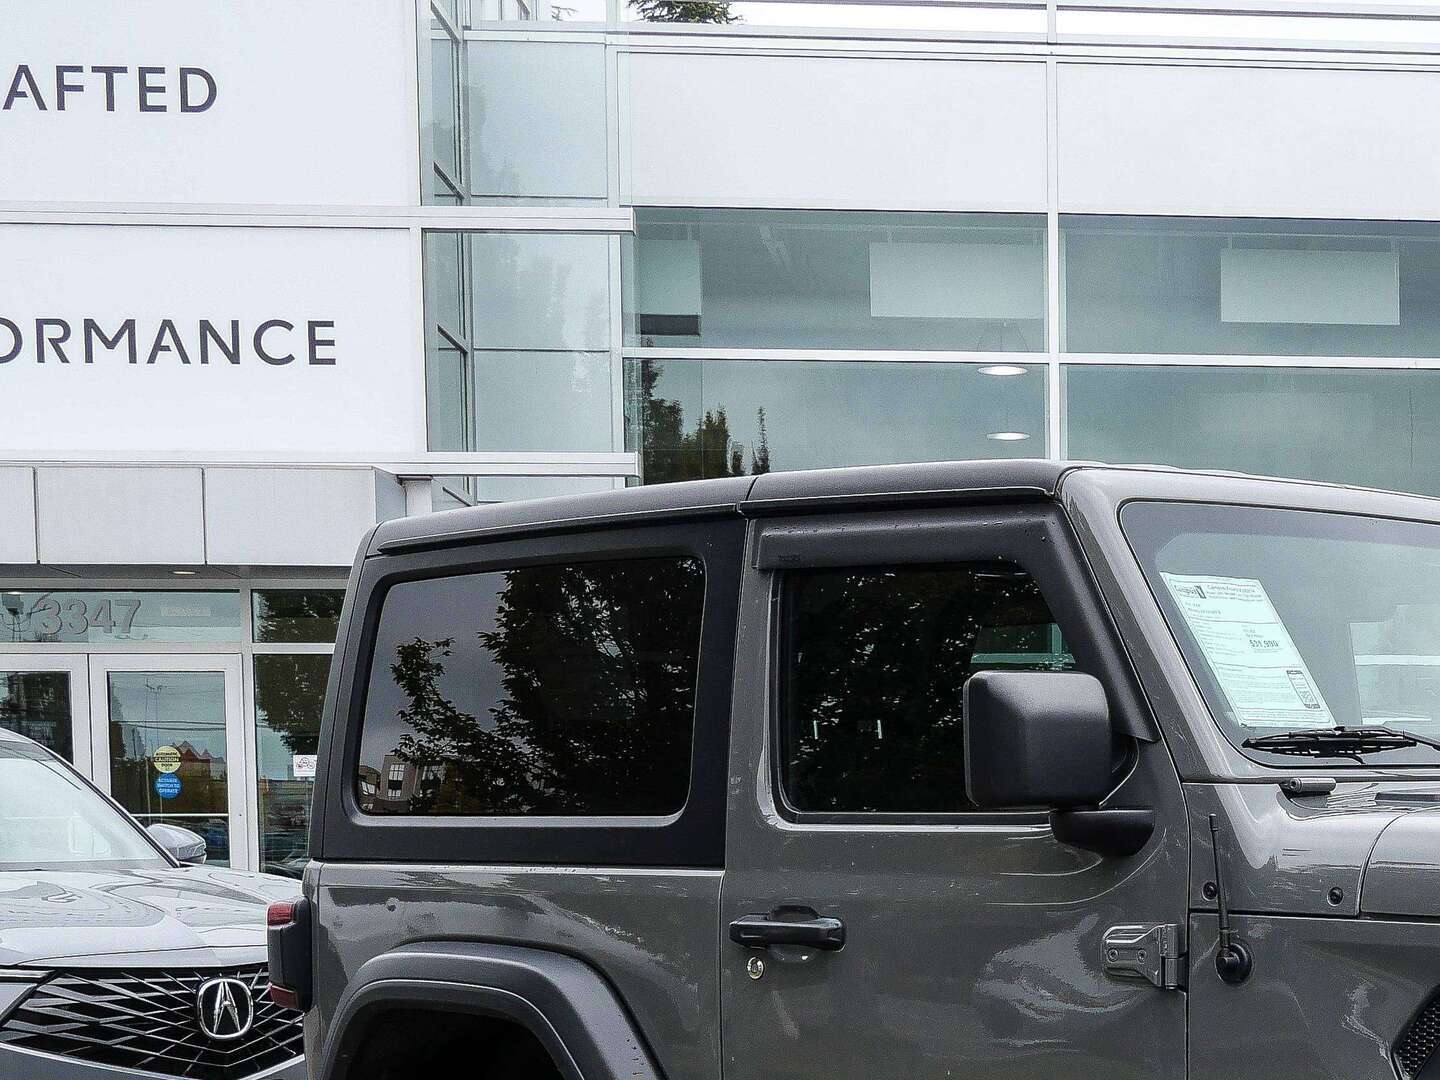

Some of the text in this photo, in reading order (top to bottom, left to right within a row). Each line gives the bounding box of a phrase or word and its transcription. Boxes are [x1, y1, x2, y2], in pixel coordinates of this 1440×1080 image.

[2, 64, 217, 113] AFTED
[0, 317, 336, 366] ORMANCE
[37, 598, 141, 635] 3347
